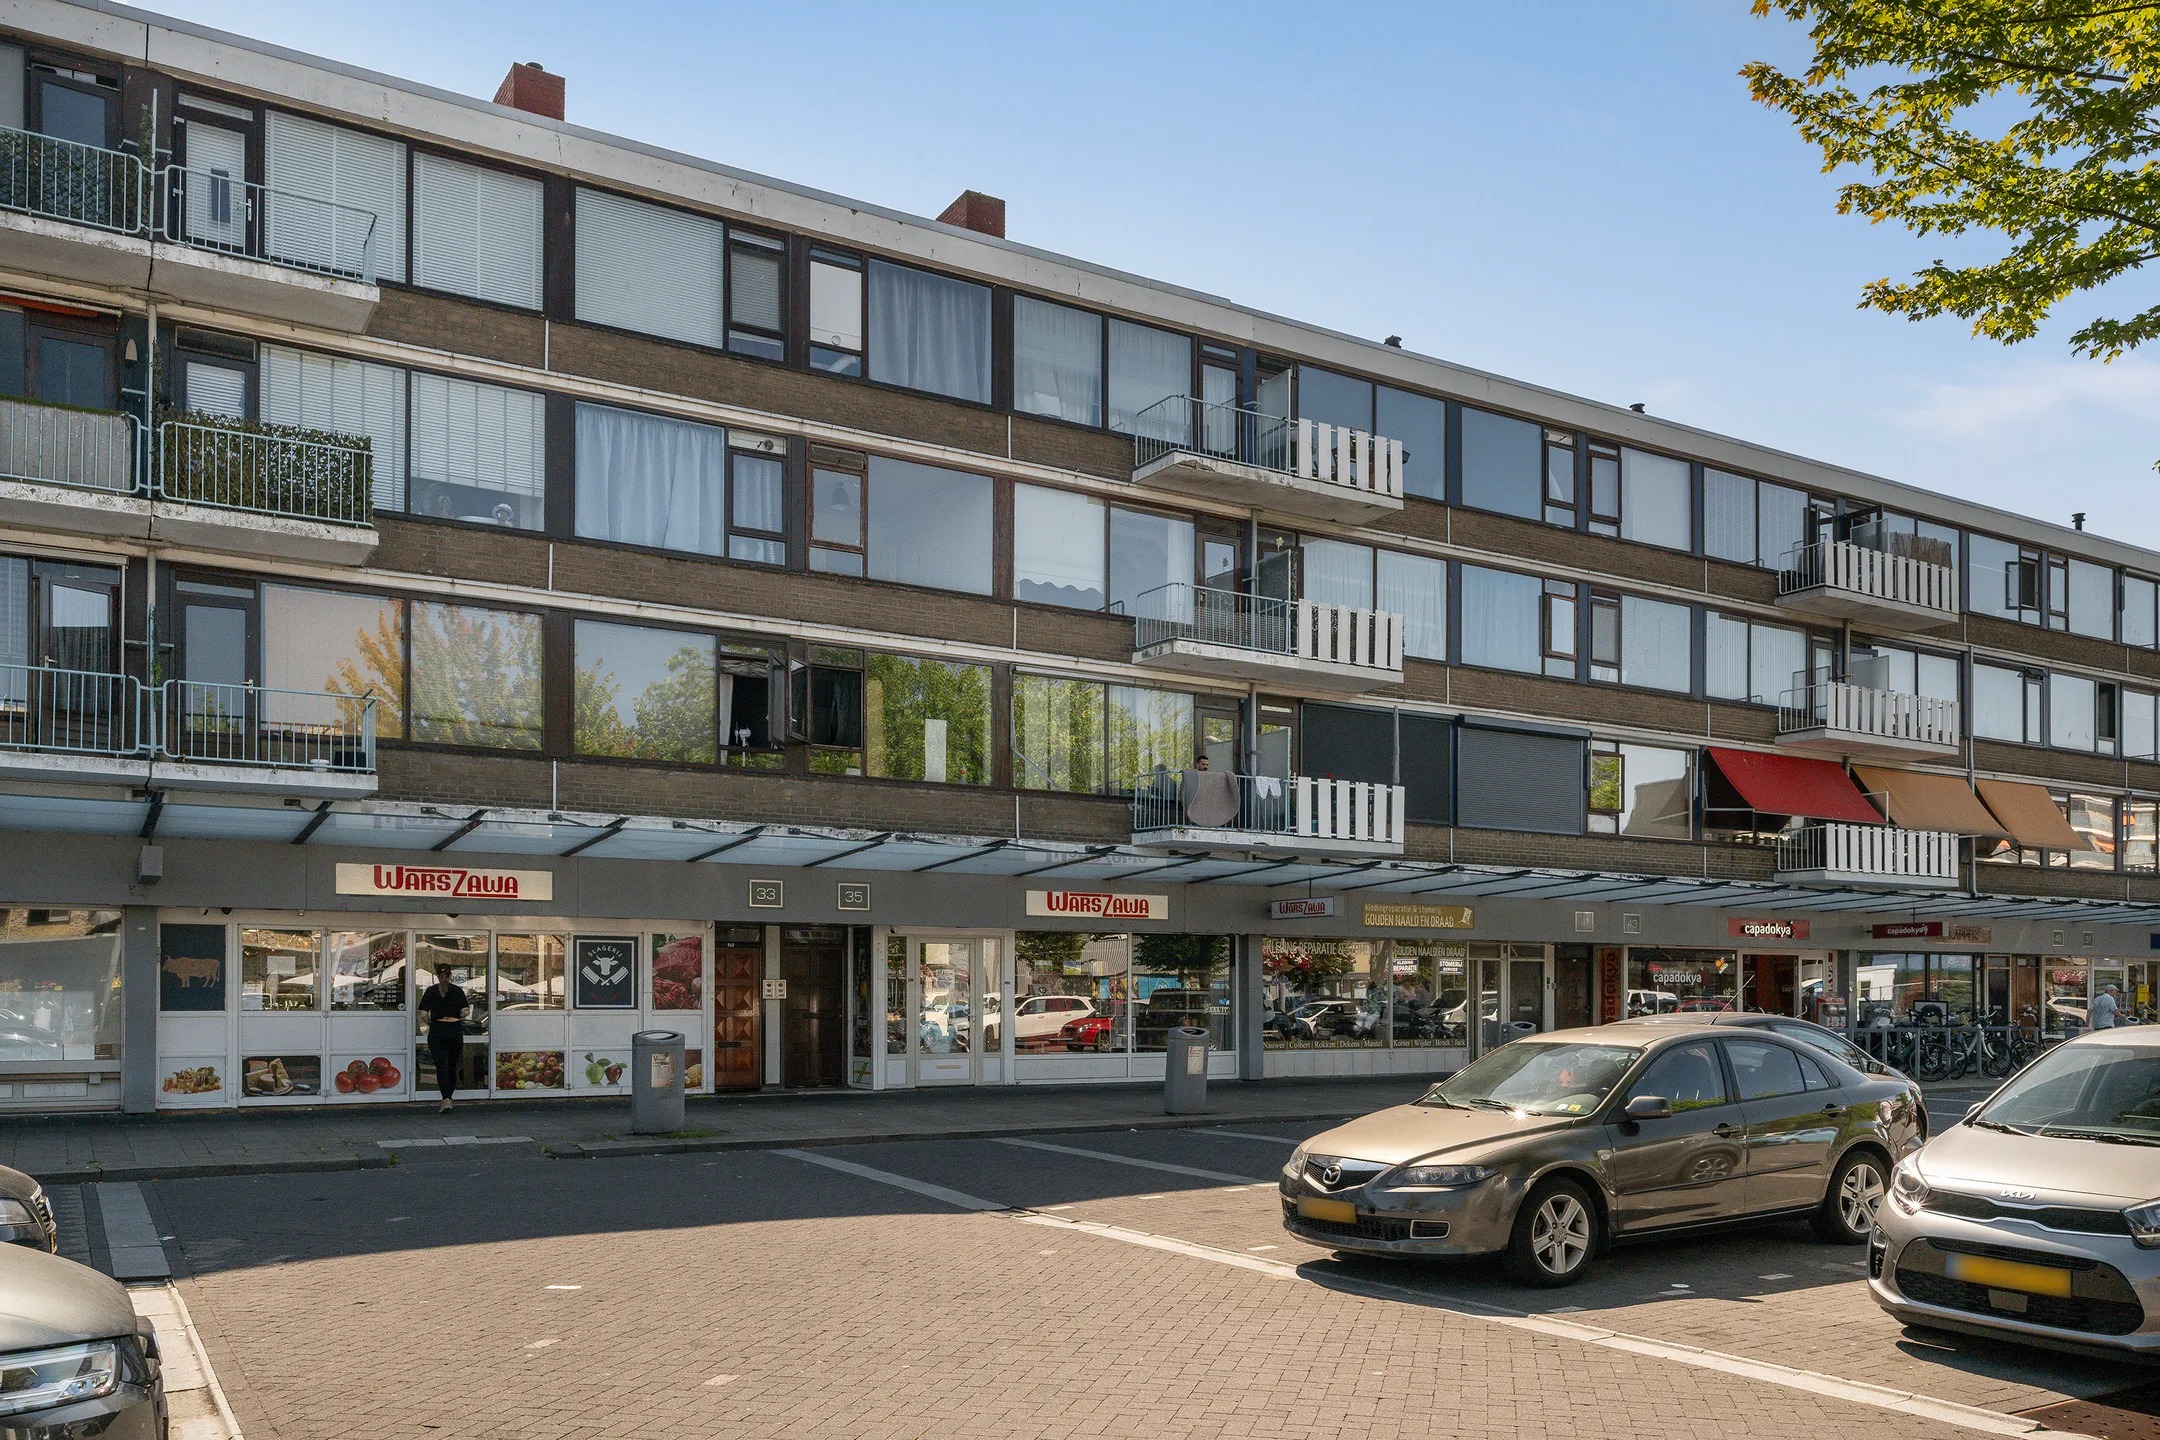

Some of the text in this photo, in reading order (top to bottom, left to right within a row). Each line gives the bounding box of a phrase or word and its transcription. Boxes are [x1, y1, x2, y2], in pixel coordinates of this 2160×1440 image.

[756, 887, 776, 900] 33
[844, 890, 863, 903] 35
[1365, 913, 1454, 928] GOUDEN NAALD EN DRAAD
[1627, 919, 1638, 928] 43
[1744, 923, 1792, 938] capadokya
[1887, 926, 1924, 935] capadokya
[587, 945, 622, 958] SLAGERIJ
[1299, 941, 1337, 955] REPARATIE
[1418, 946, 1437, 957] NAALD
[1438, 947, 1446, 957] EN
[1446, 947, 1466, 957] DRAAD
[1653, 972, 1702, 986] capadokya
[2001, 1190, 2036, 1200] KIA
